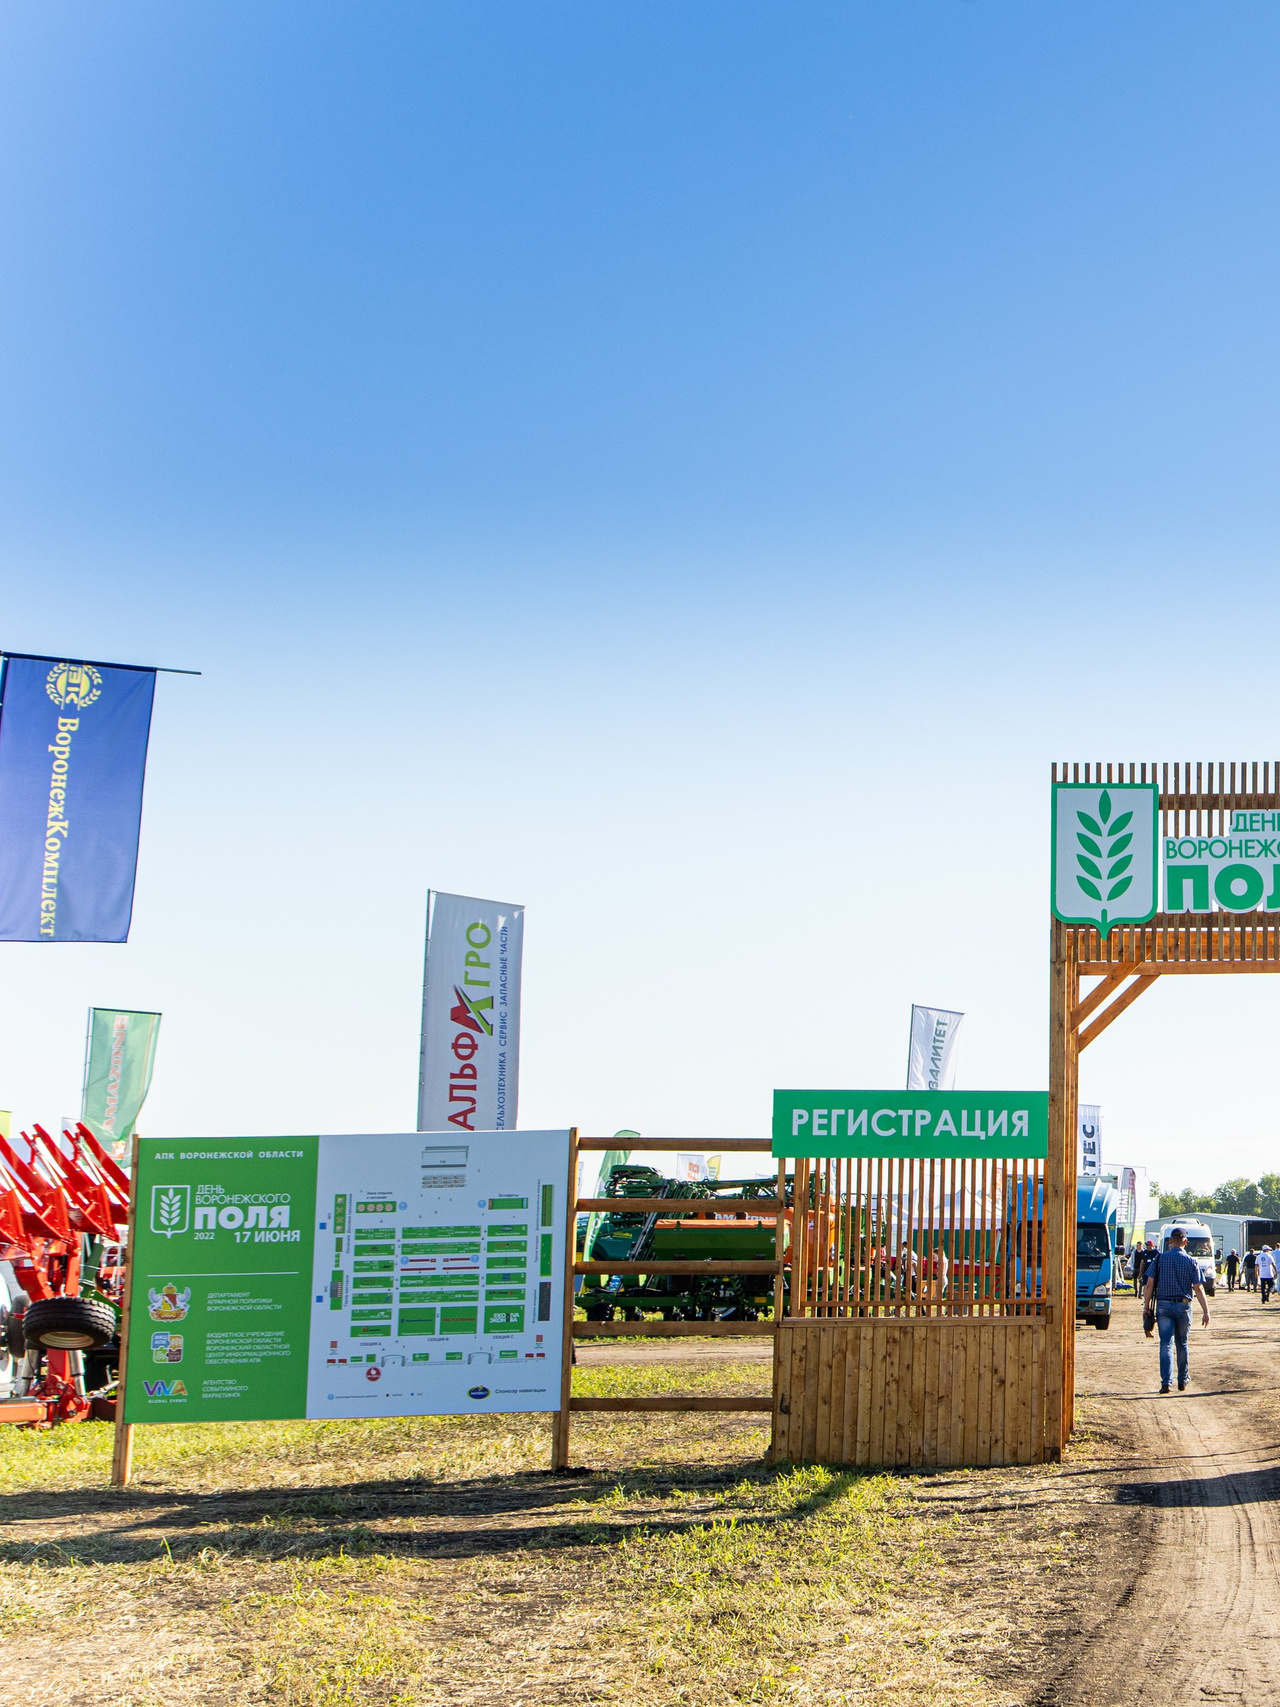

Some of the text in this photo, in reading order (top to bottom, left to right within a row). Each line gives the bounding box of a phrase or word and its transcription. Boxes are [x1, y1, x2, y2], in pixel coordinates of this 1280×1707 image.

[40, 716, 80, 937] ВоронежКомплект
[500, 926, 508, 956] ЧАСТИ
[499, 957, 508, 1006] ЗАПАСНЫЕ
[499, 1011, 507, 1046] СЕРВИС
[103, 1014, 129, 1134] AMAZONE
[792, 1109, 1029, 1140] РЕГИСТРАЦИЯ
[155, 1150, 304, 1160] АПК ВОРОНЕЖСКОЙ ОБЛАСТИ
[195, 1193, 291, 1205] ВОРОНЕЖСКОГО
[196, 1184, 225, 1195] ДЕНЬ
[194, 1205, 291, 1230] ПОЛЯ
[194, 1232, 215, 1240] 2022
[234, 1230, 301, 1243] 17 ИЮНЯ
